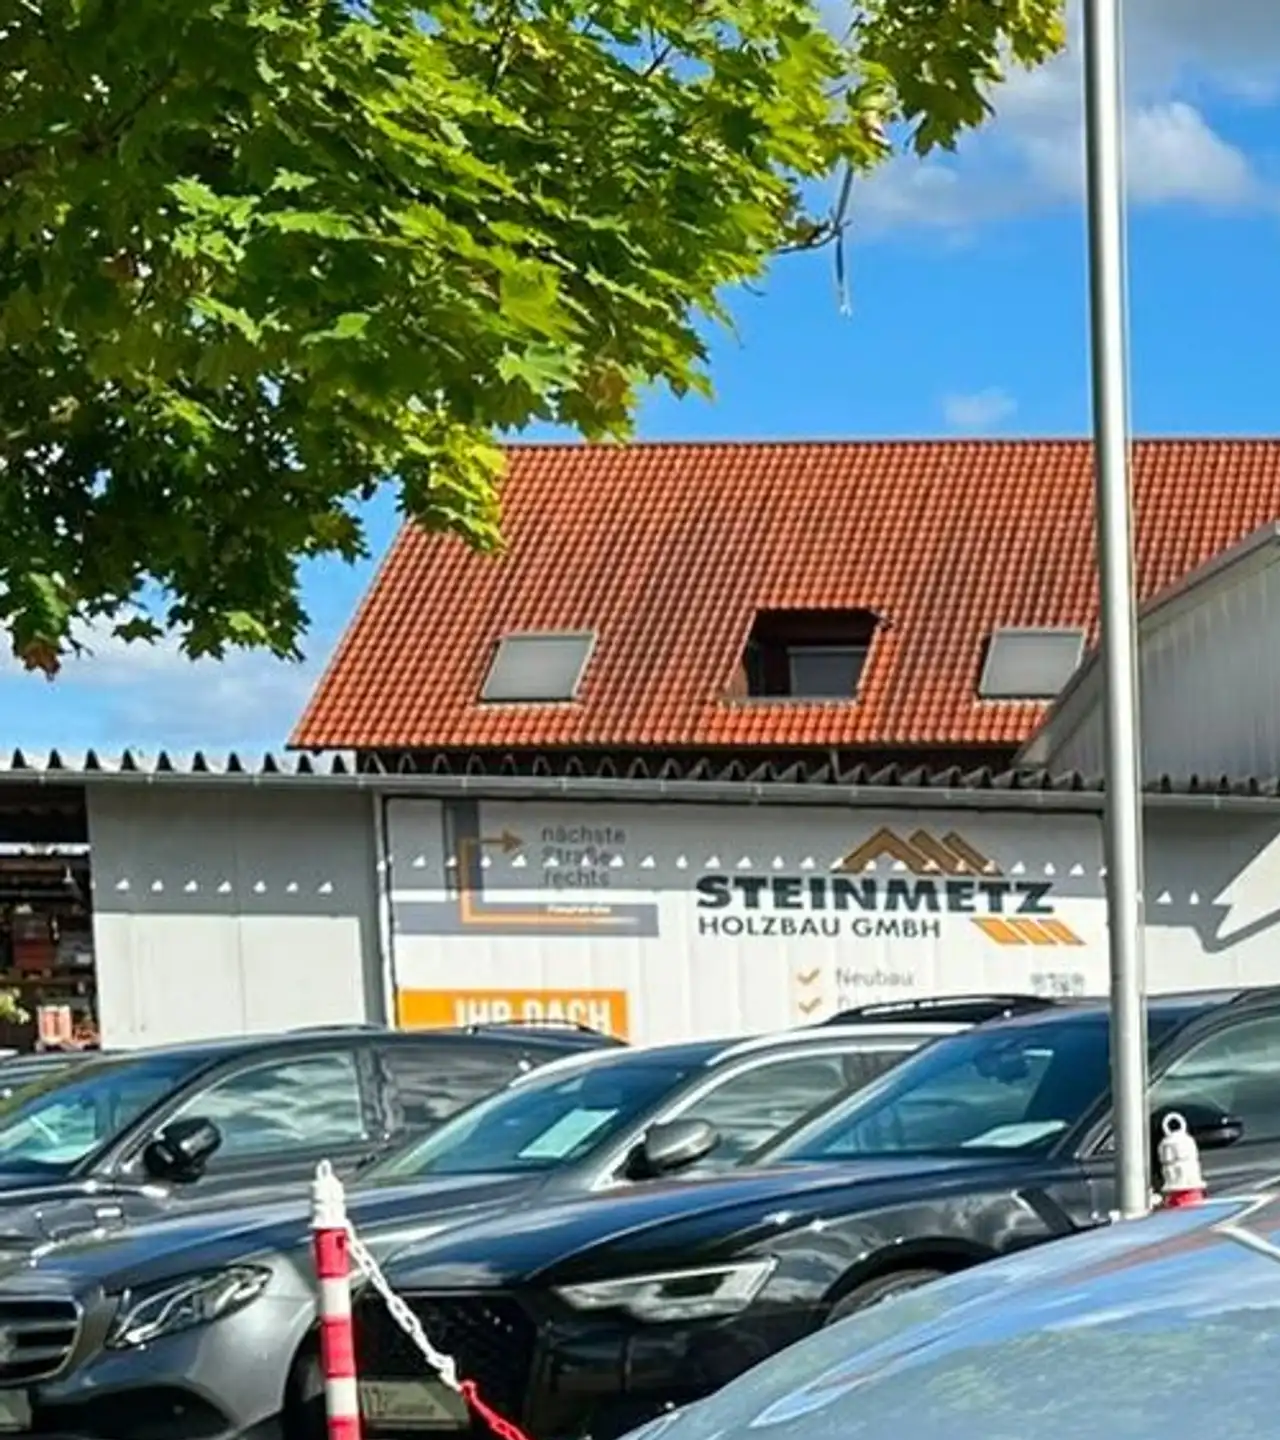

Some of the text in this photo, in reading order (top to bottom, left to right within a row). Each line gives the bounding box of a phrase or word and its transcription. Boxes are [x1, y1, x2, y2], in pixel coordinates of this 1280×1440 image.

[541, 824, 627, 844] nächste
[695, 875, 1056, 914] STEINMETZ
[699, 914, 942, 940] HOLZBAU GMBH
[835, 967, 915, 988] Neubau
[455, 997, 512, 1030] IHR
